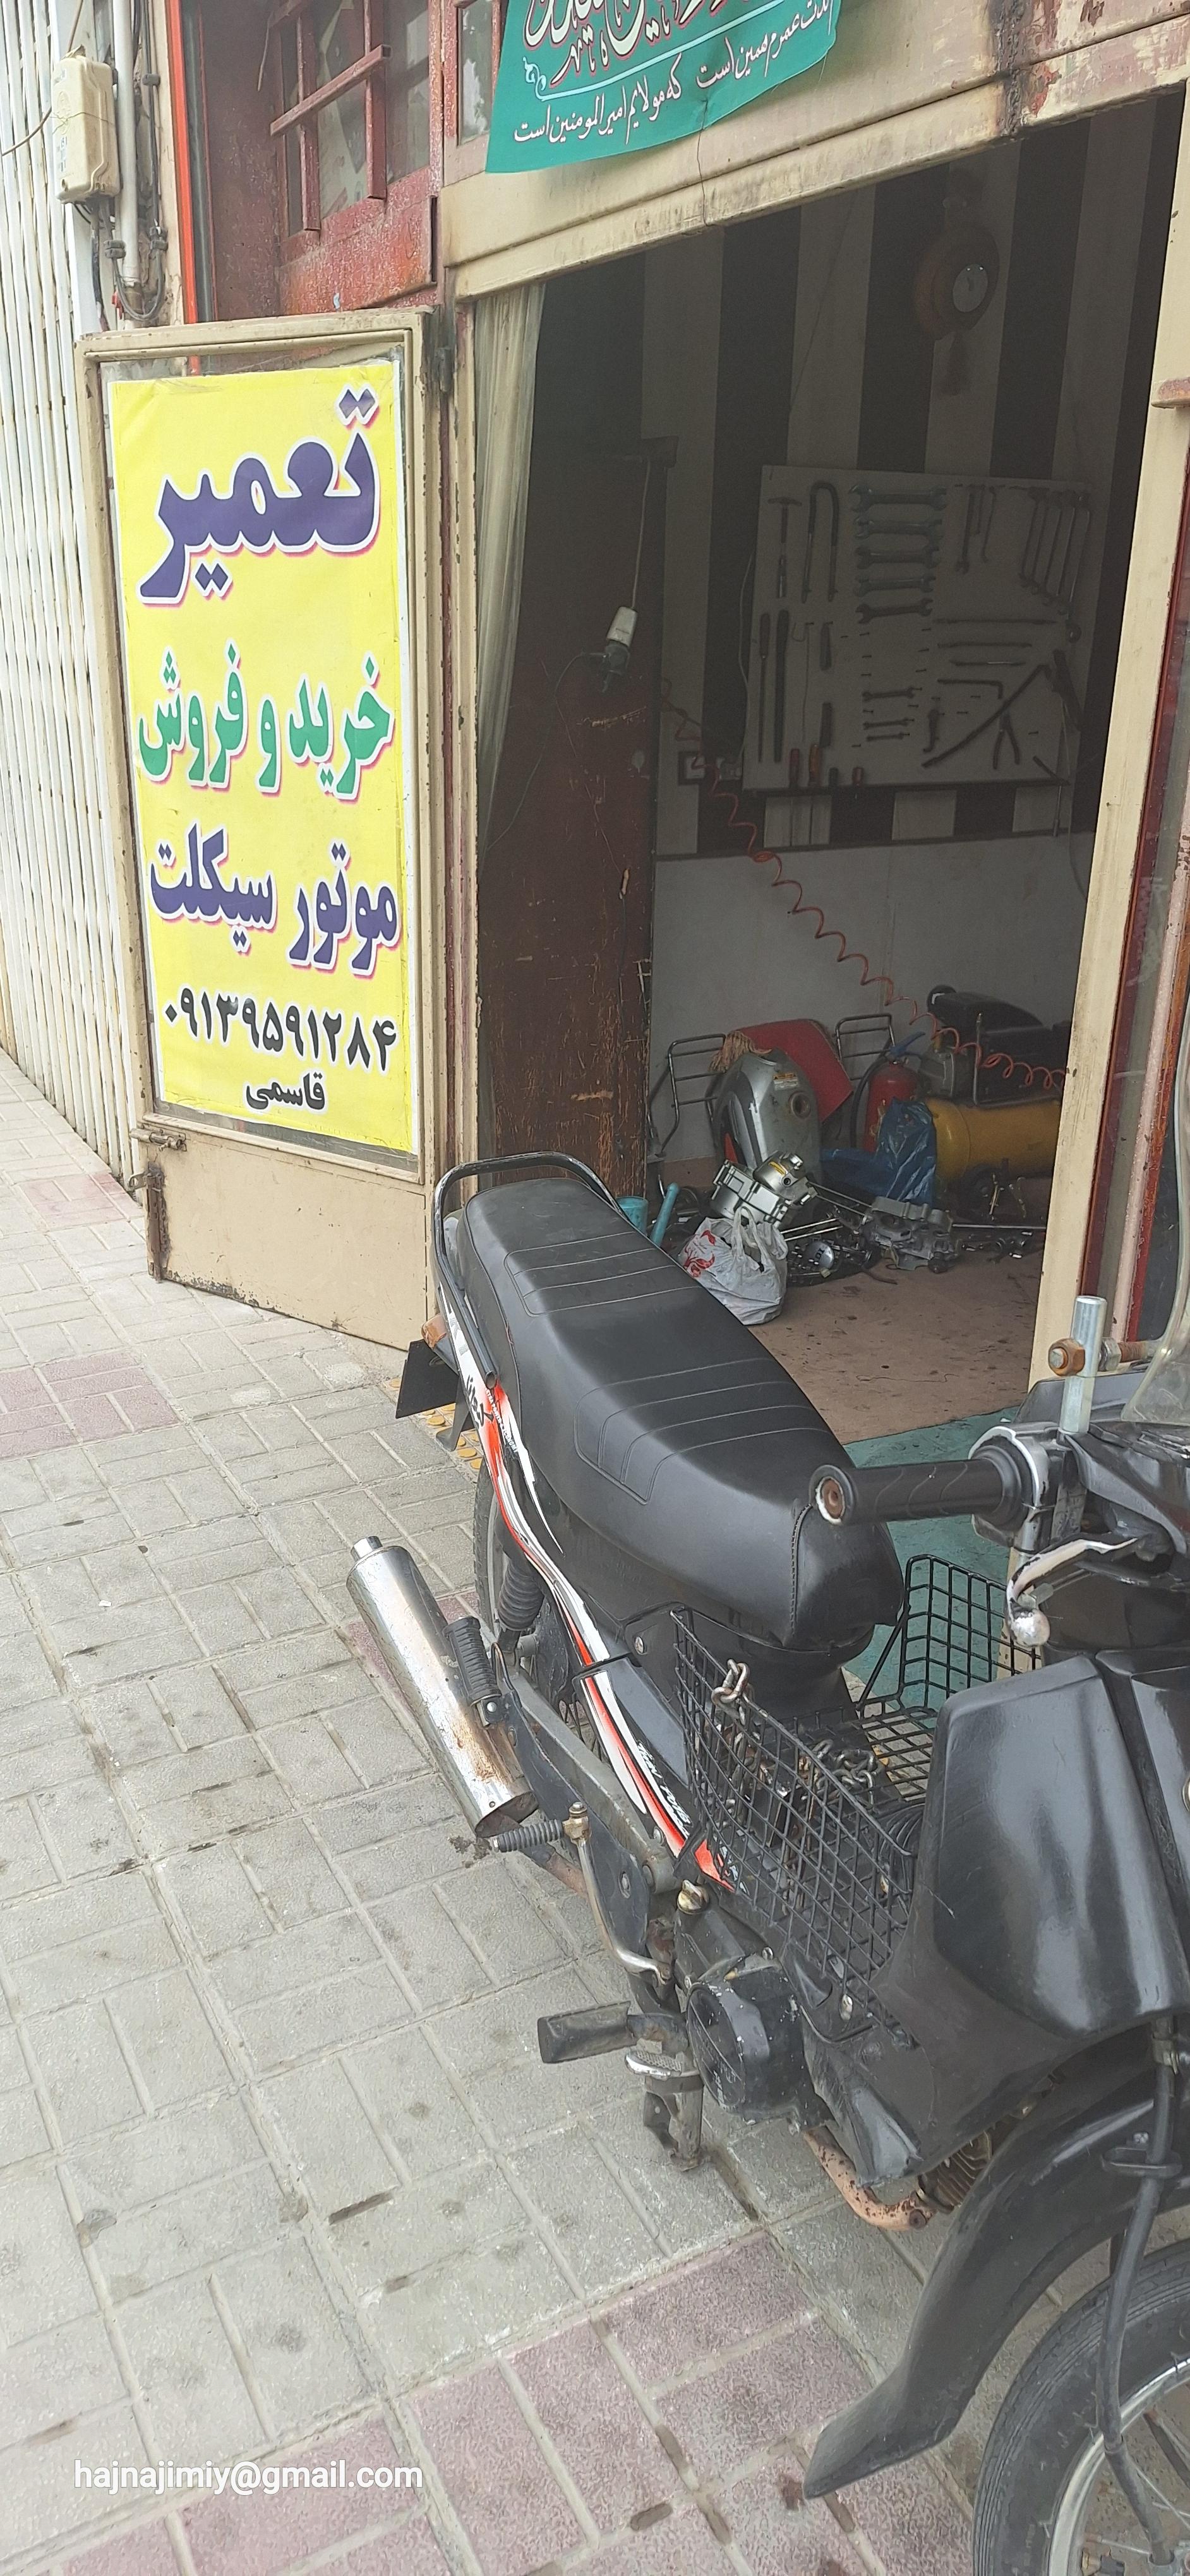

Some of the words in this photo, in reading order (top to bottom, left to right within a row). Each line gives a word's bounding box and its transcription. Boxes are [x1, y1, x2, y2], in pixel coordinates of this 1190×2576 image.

[666, 52, 682, 99] که
[696, 36, 735, 88] است
[735, 33, 768, 80] همین
[763, 13, 800, 78] عمرم
[514, 104, 551, 142] است
[625, 75, 665, 145] مولایم
[138, 386, 378, 600] تعمیر
[138, 642, 244, 784] فروش
[258, 698, 277, 789] و
[289, 655, 391, 795] خرید
[149, 823, 274, 948] سیکلت
[288, 842, 397, 971] موتور
[165, 987, 397, 1071] ۰۹۱۳۹۵۹۱۲۸۴
[246, 1072, 326, 1110] قاسمی
